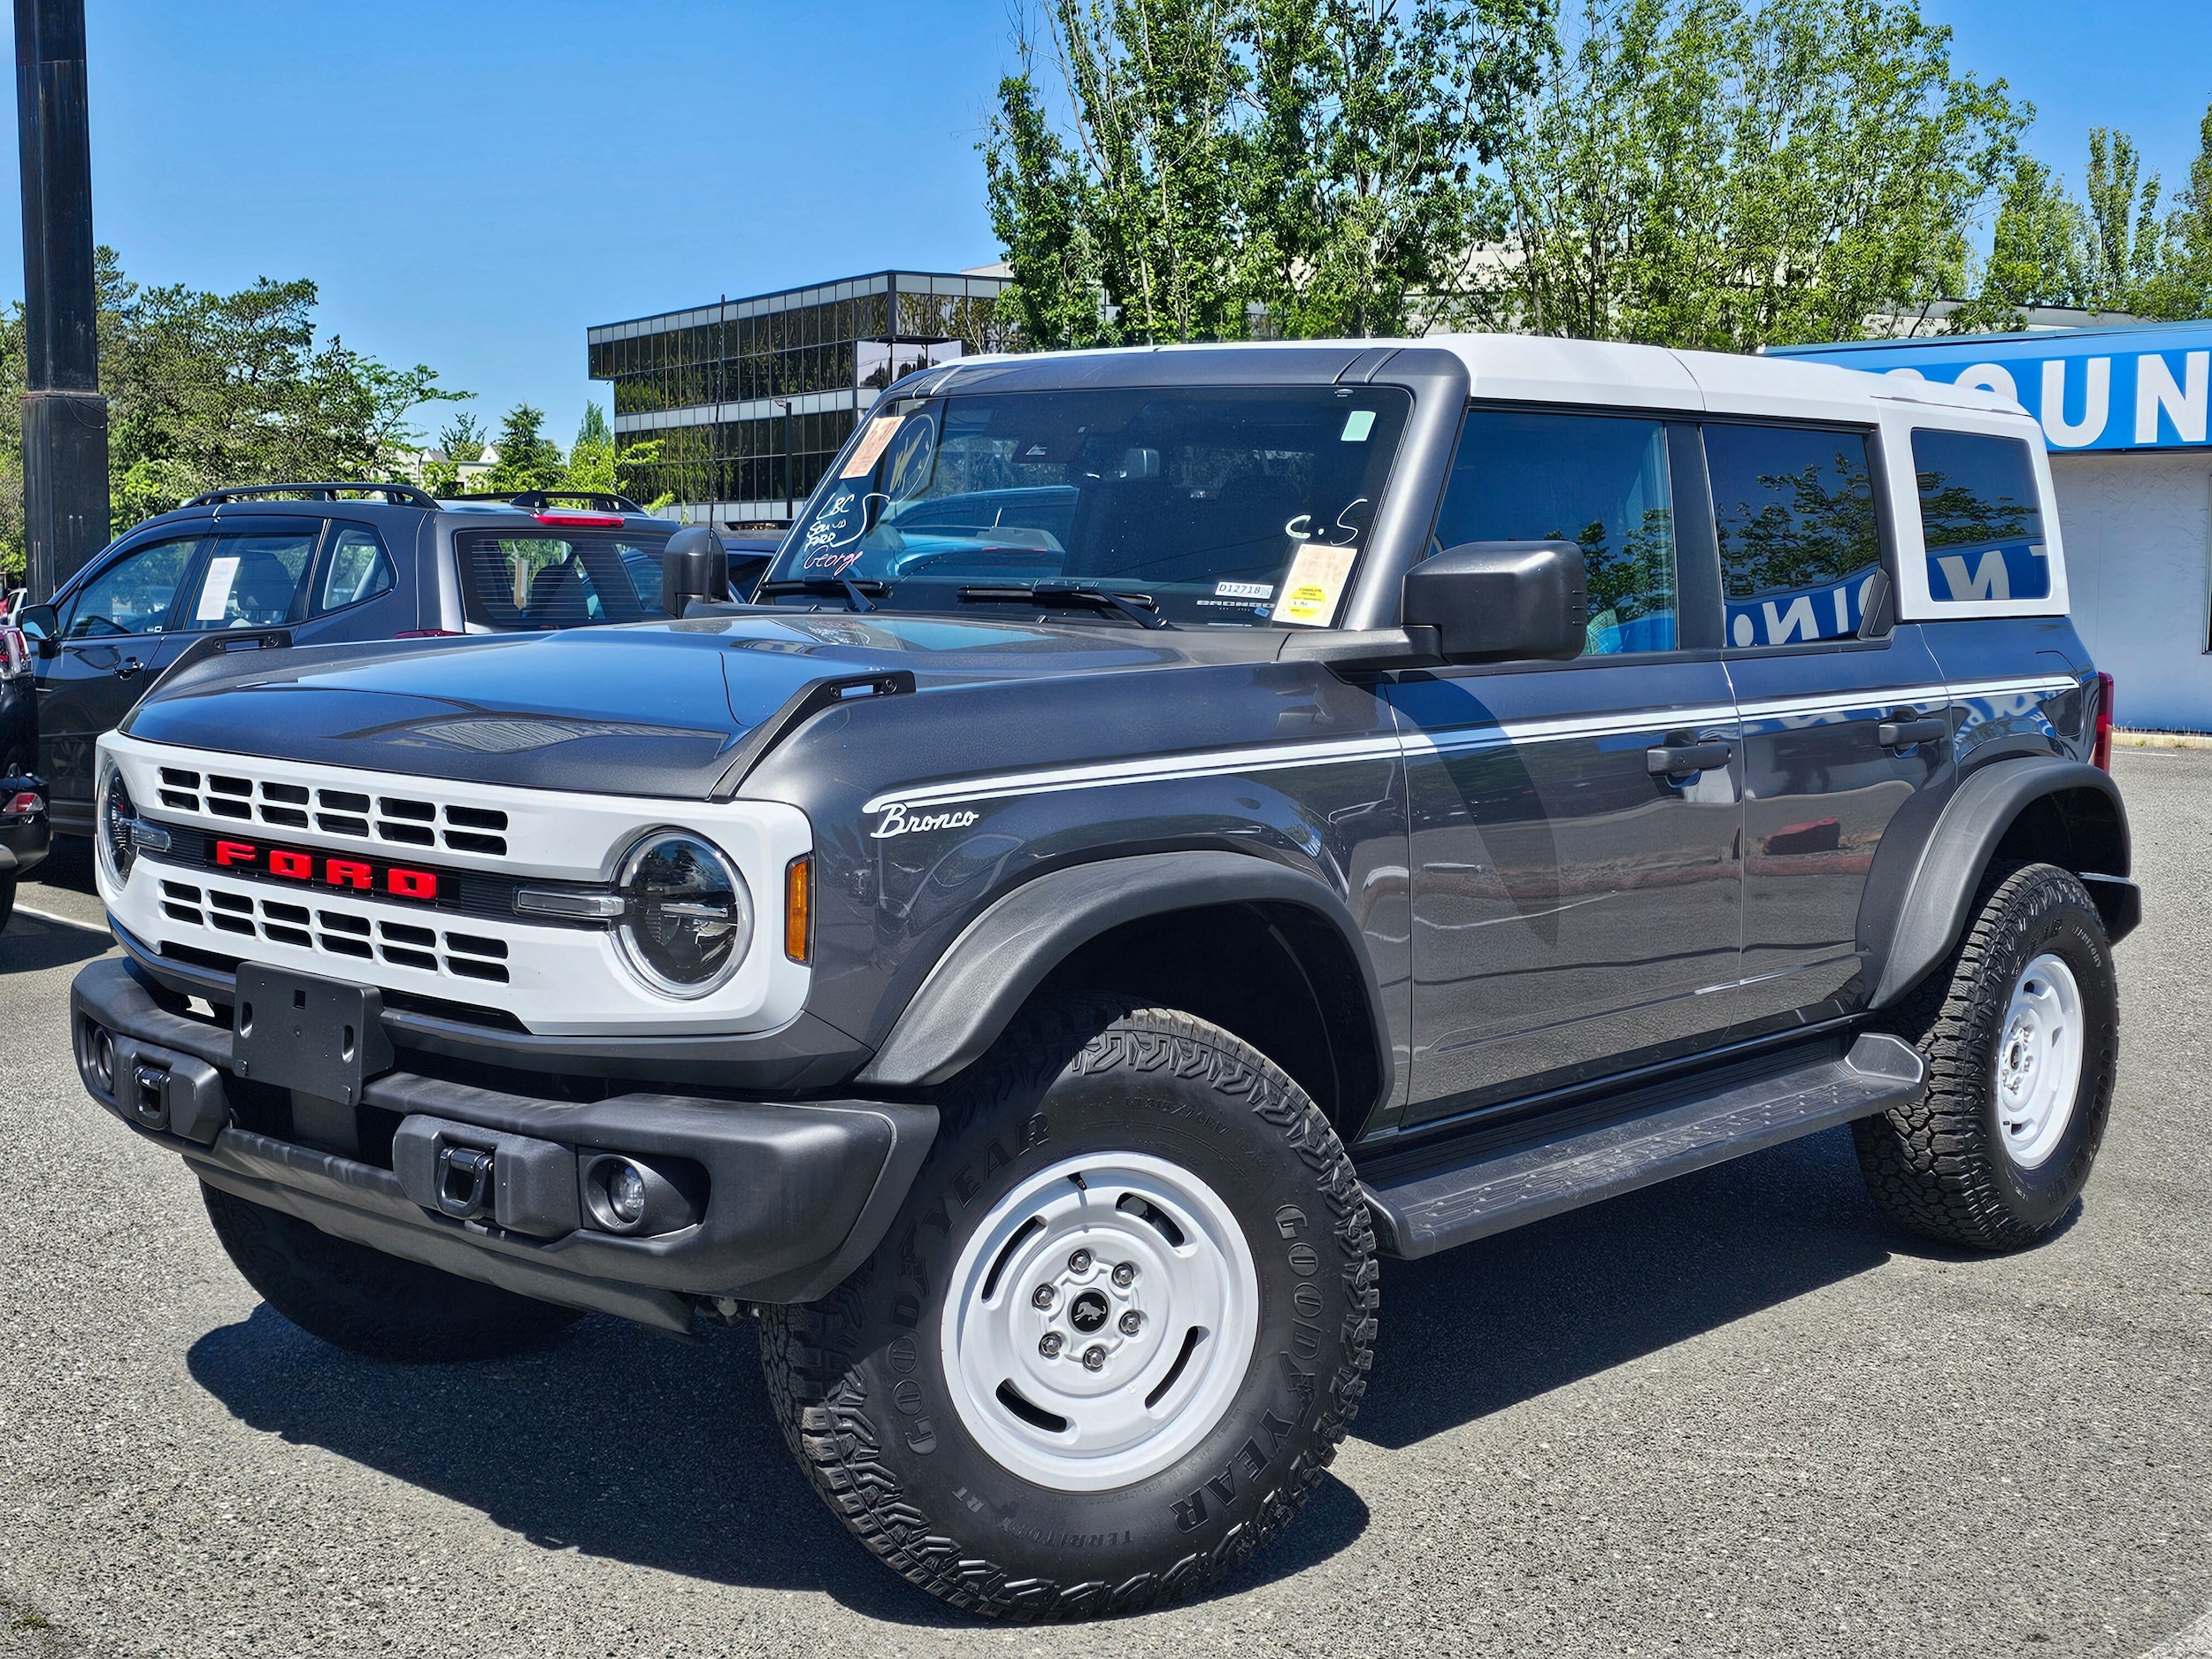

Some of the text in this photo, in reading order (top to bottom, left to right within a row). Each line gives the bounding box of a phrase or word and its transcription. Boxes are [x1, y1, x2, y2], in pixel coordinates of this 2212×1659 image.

[816, 493, 855, 520] LBC
[803, 546, 864, 576] George
[1218, 583, 1261, 595] D12718
[870, 803, 979, 839] Bronco
[216, 841, 436, 899] FORD
